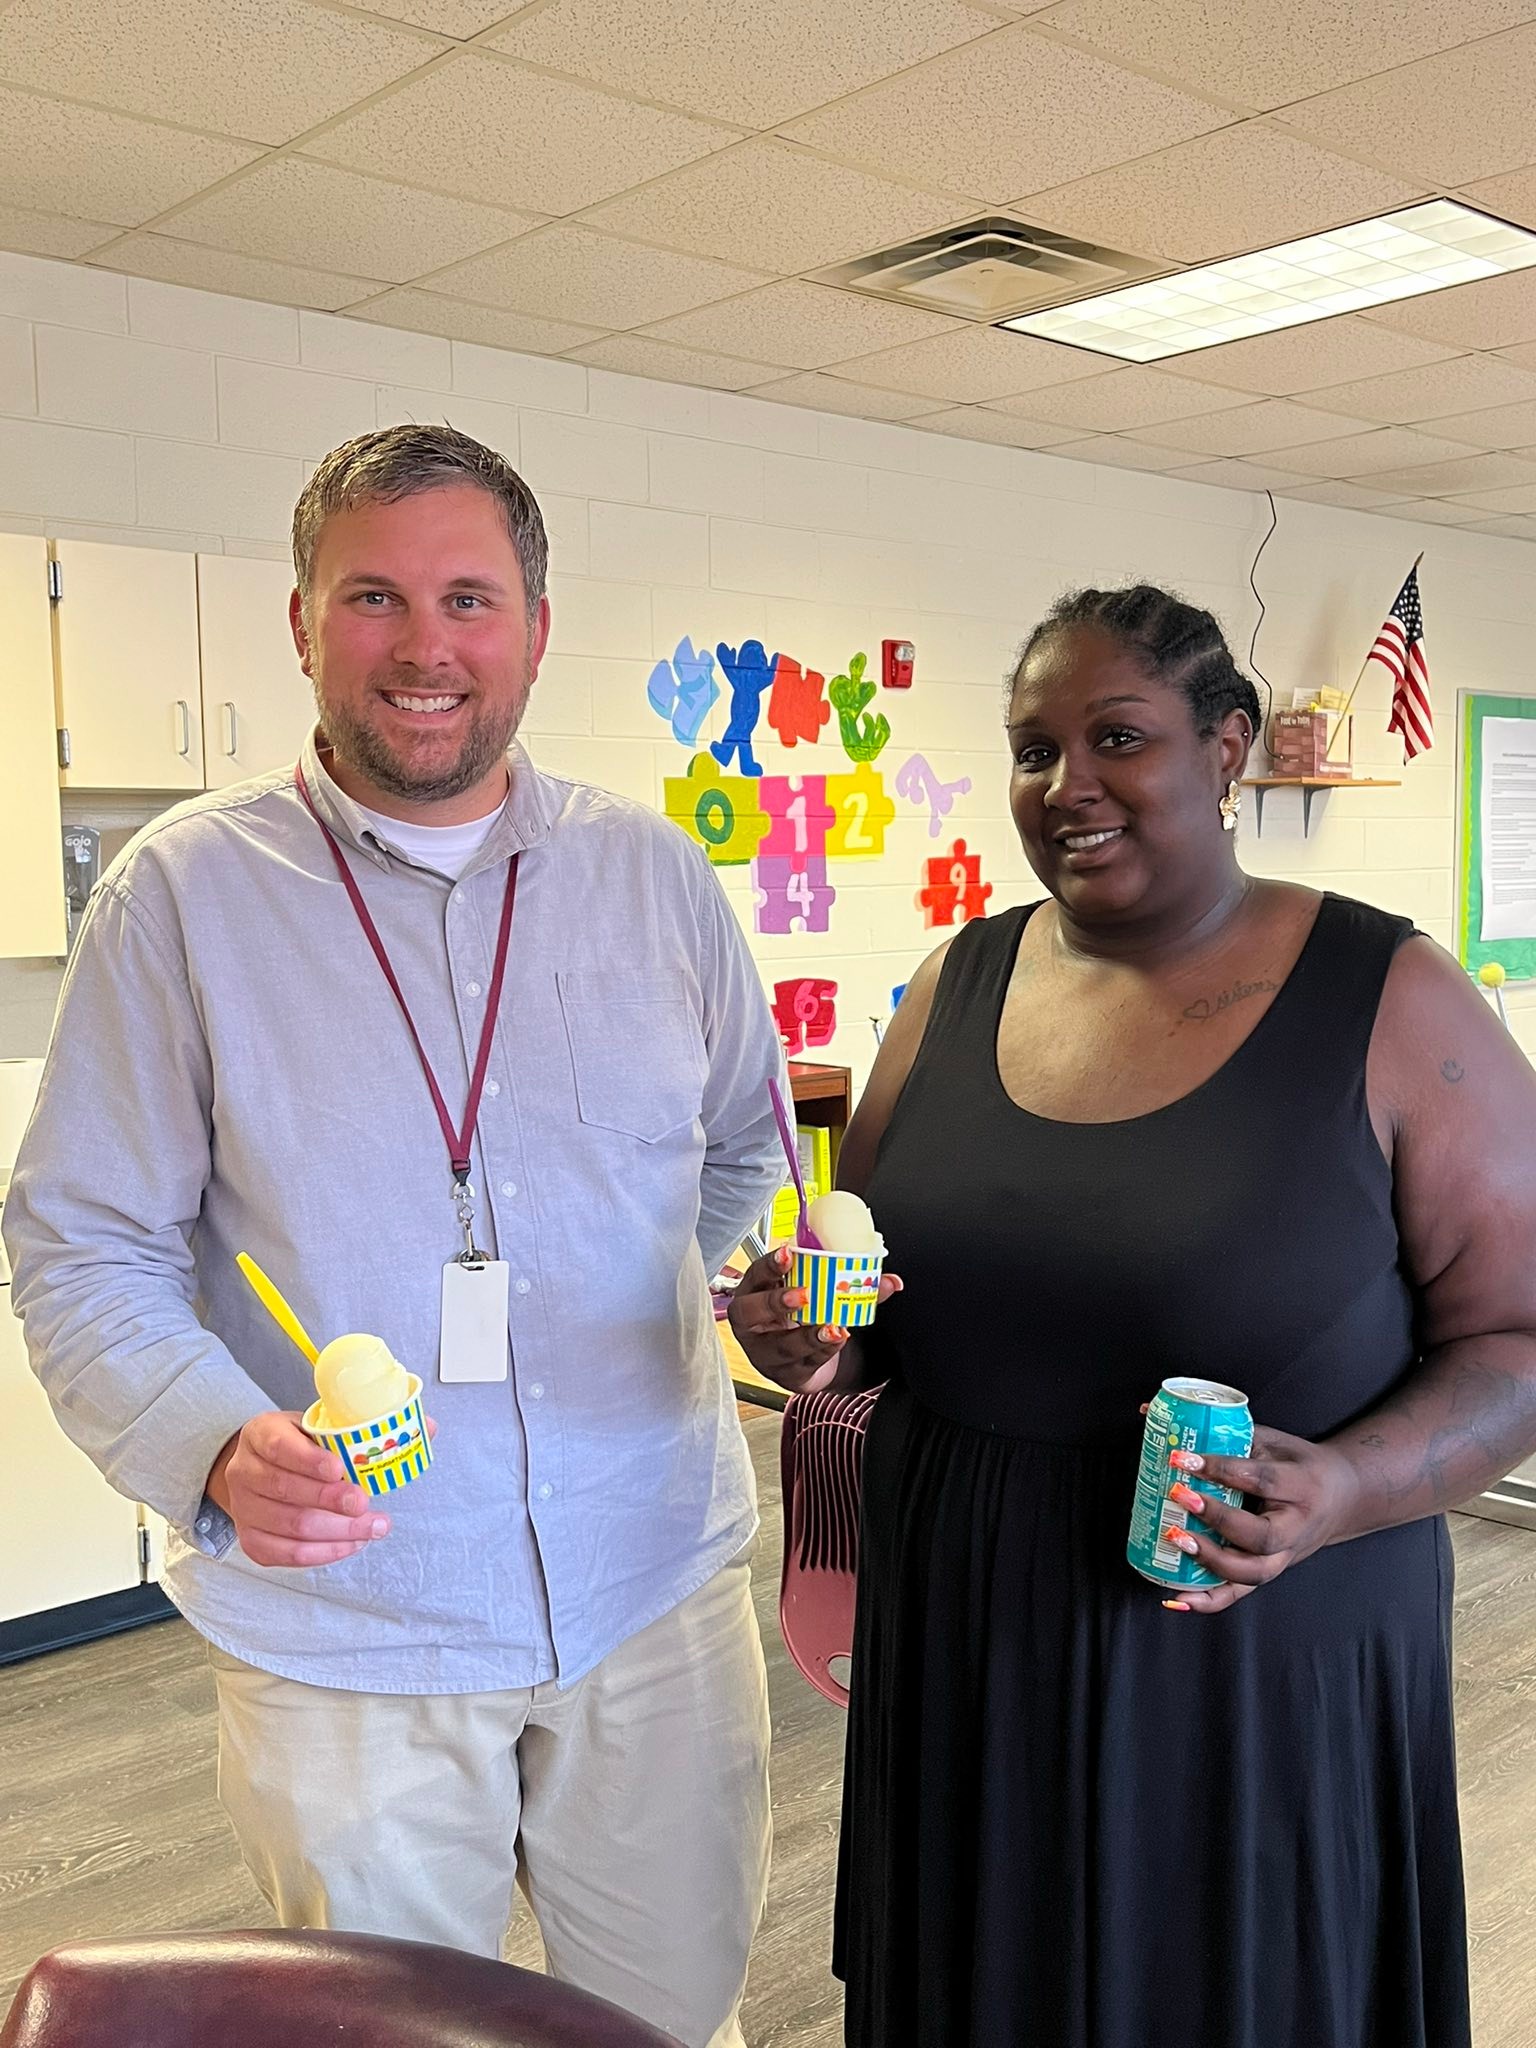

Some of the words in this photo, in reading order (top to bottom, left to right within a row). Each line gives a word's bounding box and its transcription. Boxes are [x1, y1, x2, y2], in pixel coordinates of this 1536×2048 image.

[785, 796, 808, 852] 1
[843, 792, 874, 849] 2
[787, 872, 814, 917] 4
[949, 863, 967, 901] 9
[794, 980, 819, 1022] 6
[1152, 1432, 1166, 1447] 170
